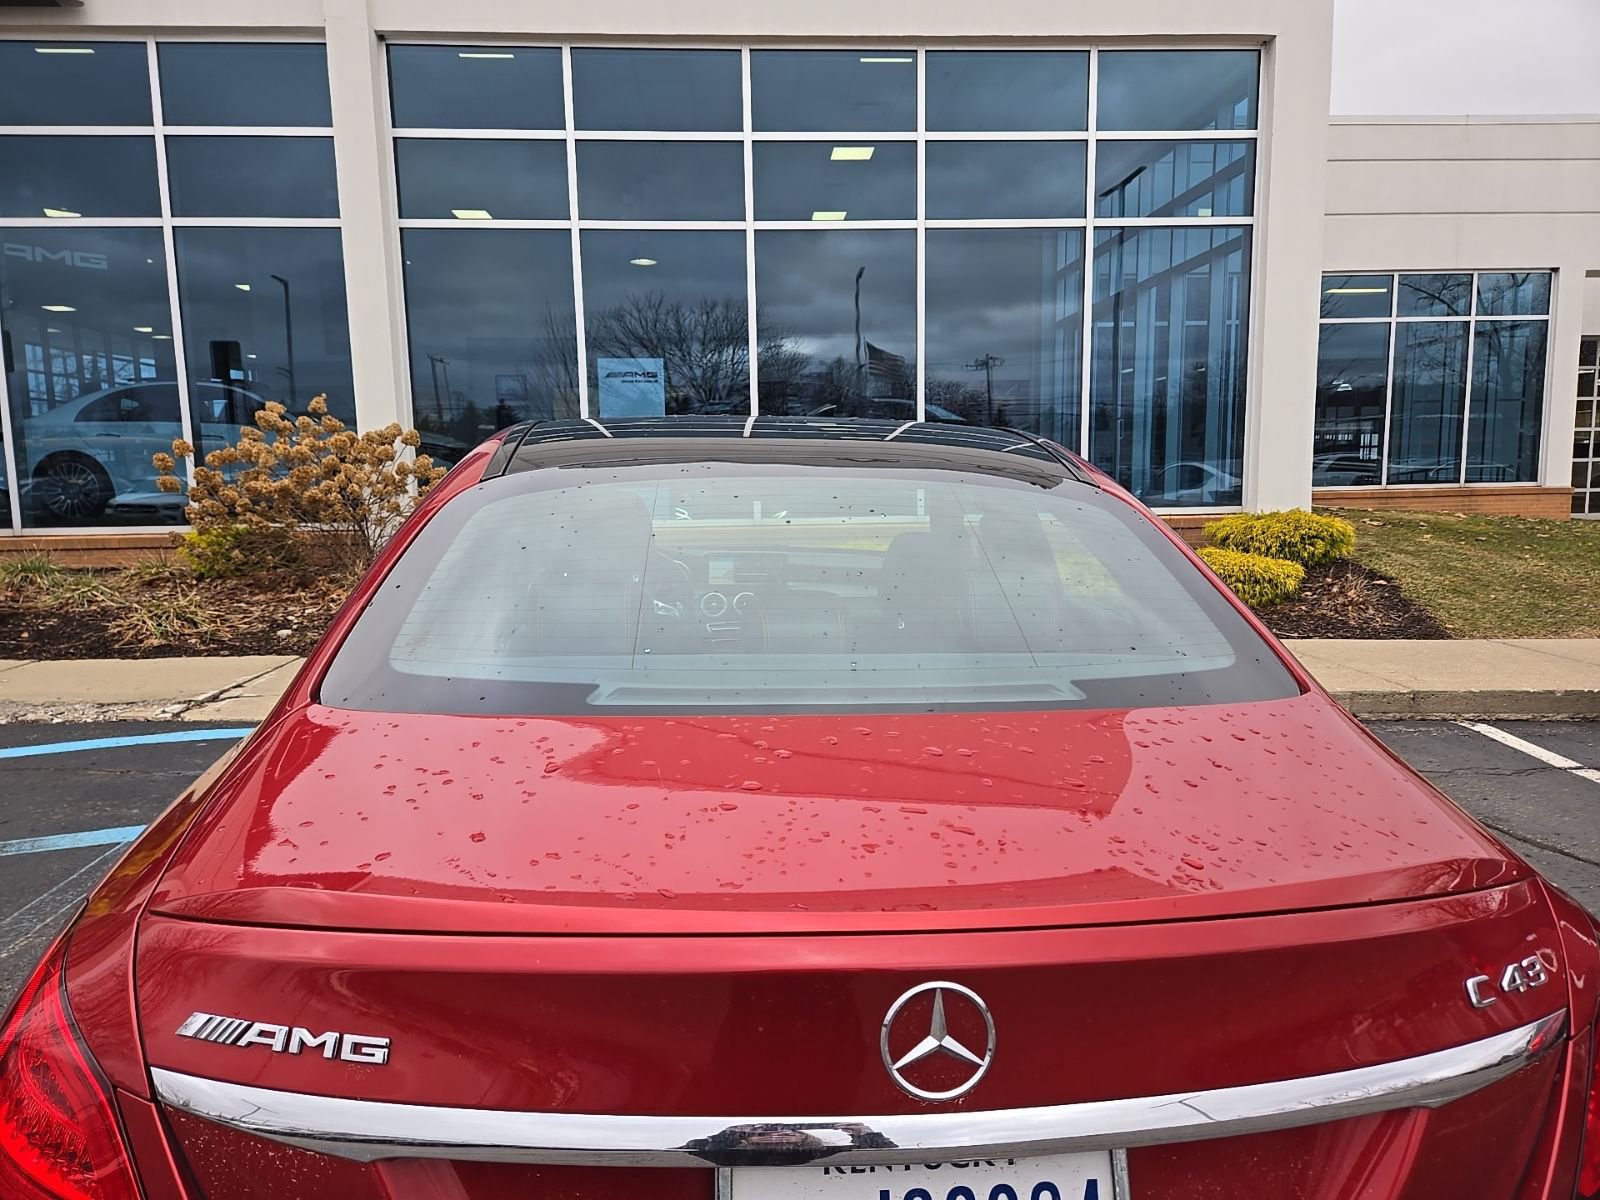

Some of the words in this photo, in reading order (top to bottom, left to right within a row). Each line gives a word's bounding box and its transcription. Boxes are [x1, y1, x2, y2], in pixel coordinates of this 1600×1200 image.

[3, 243, 108, 269] AMG
[1465, 974, 1497, 1008] C
[1500, 955, 1547, 993] 43
[236, 1021, 391, 1065] AMG
